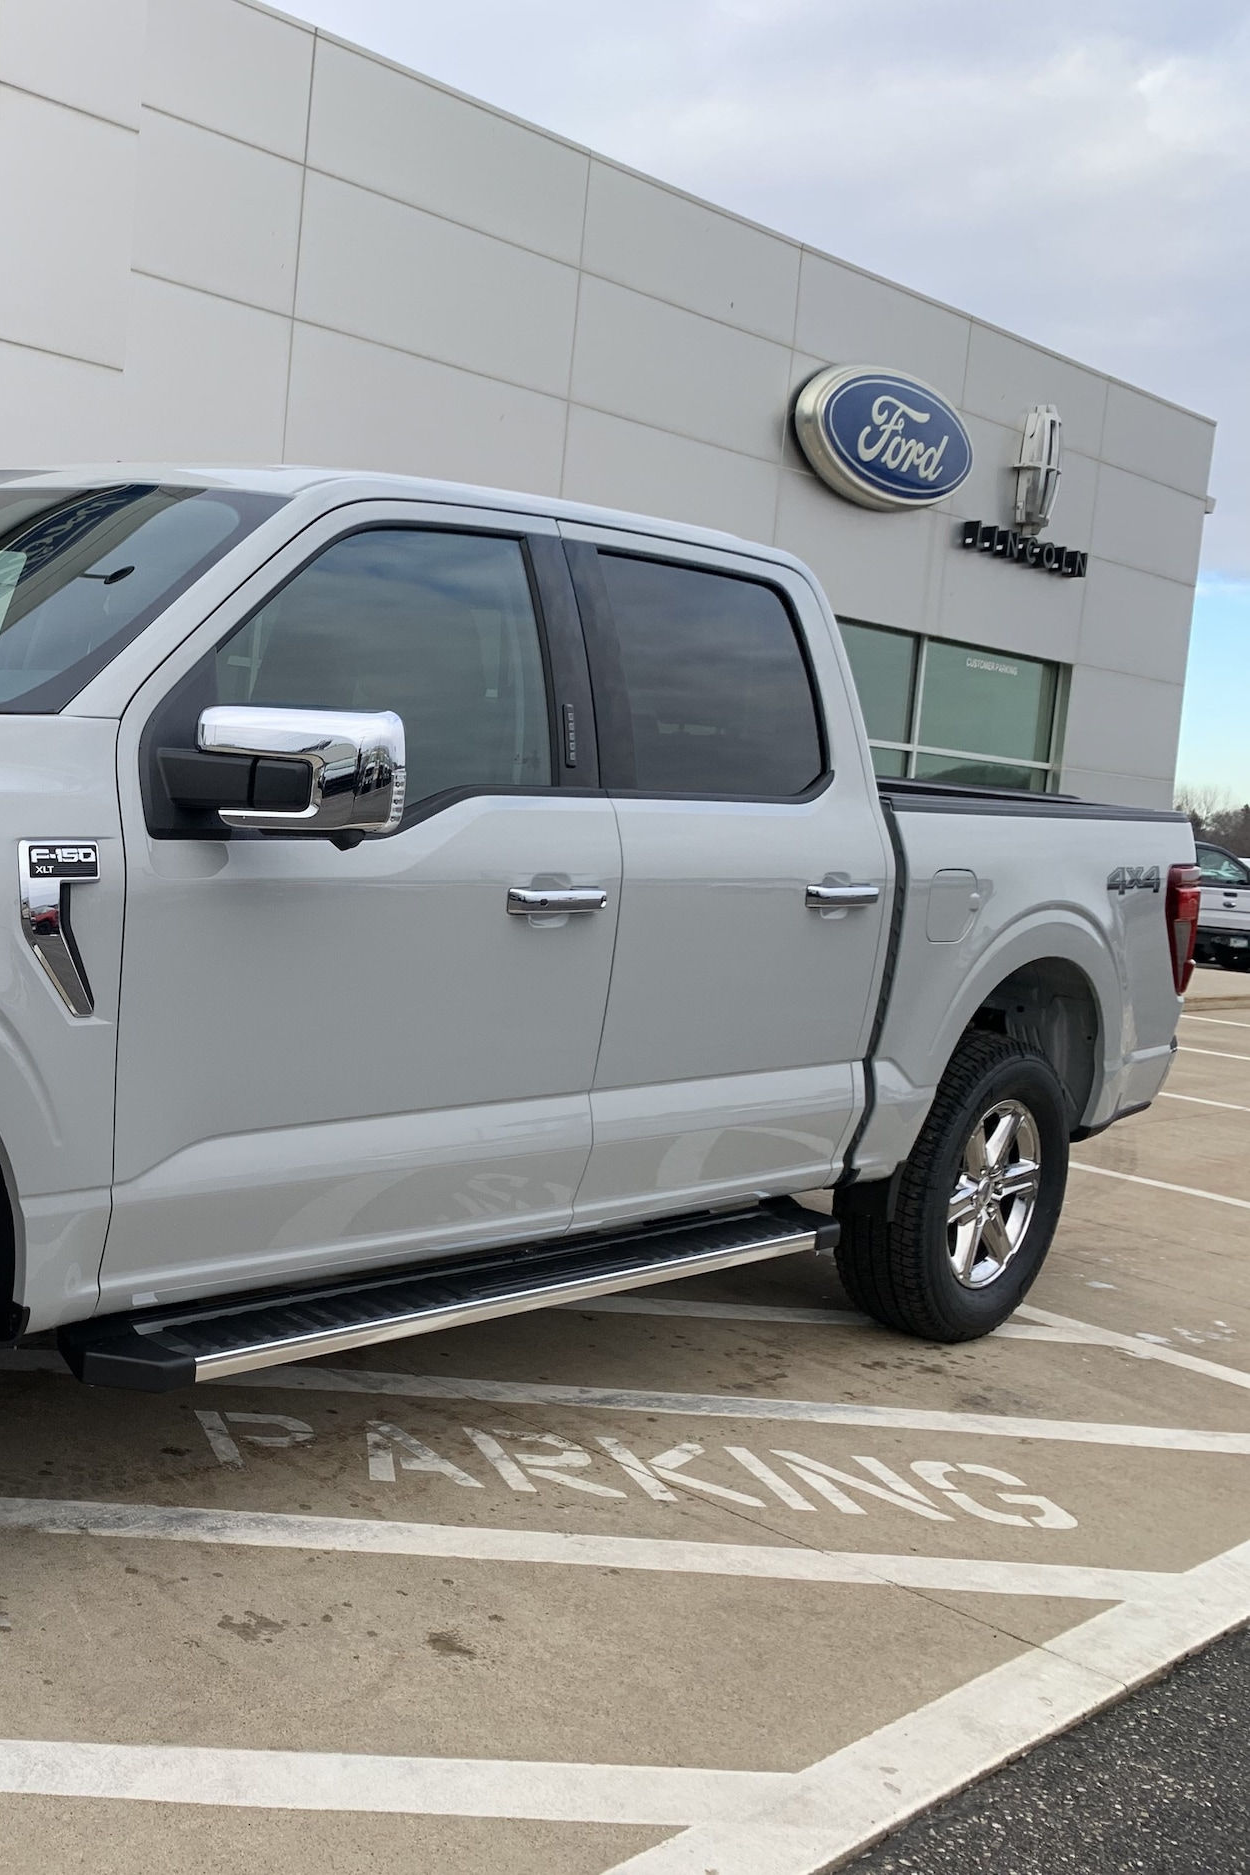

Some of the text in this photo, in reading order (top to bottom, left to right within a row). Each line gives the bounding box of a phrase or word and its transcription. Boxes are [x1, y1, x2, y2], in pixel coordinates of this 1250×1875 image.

[857, 395, 949, 482] Ford
[964, 520, 1088, 578] LINCOLN
[30, 847, 96, 863] F-150
[35, 865, 54, 874] XLT
[192, 1408, 1079, 1530] PARKING
